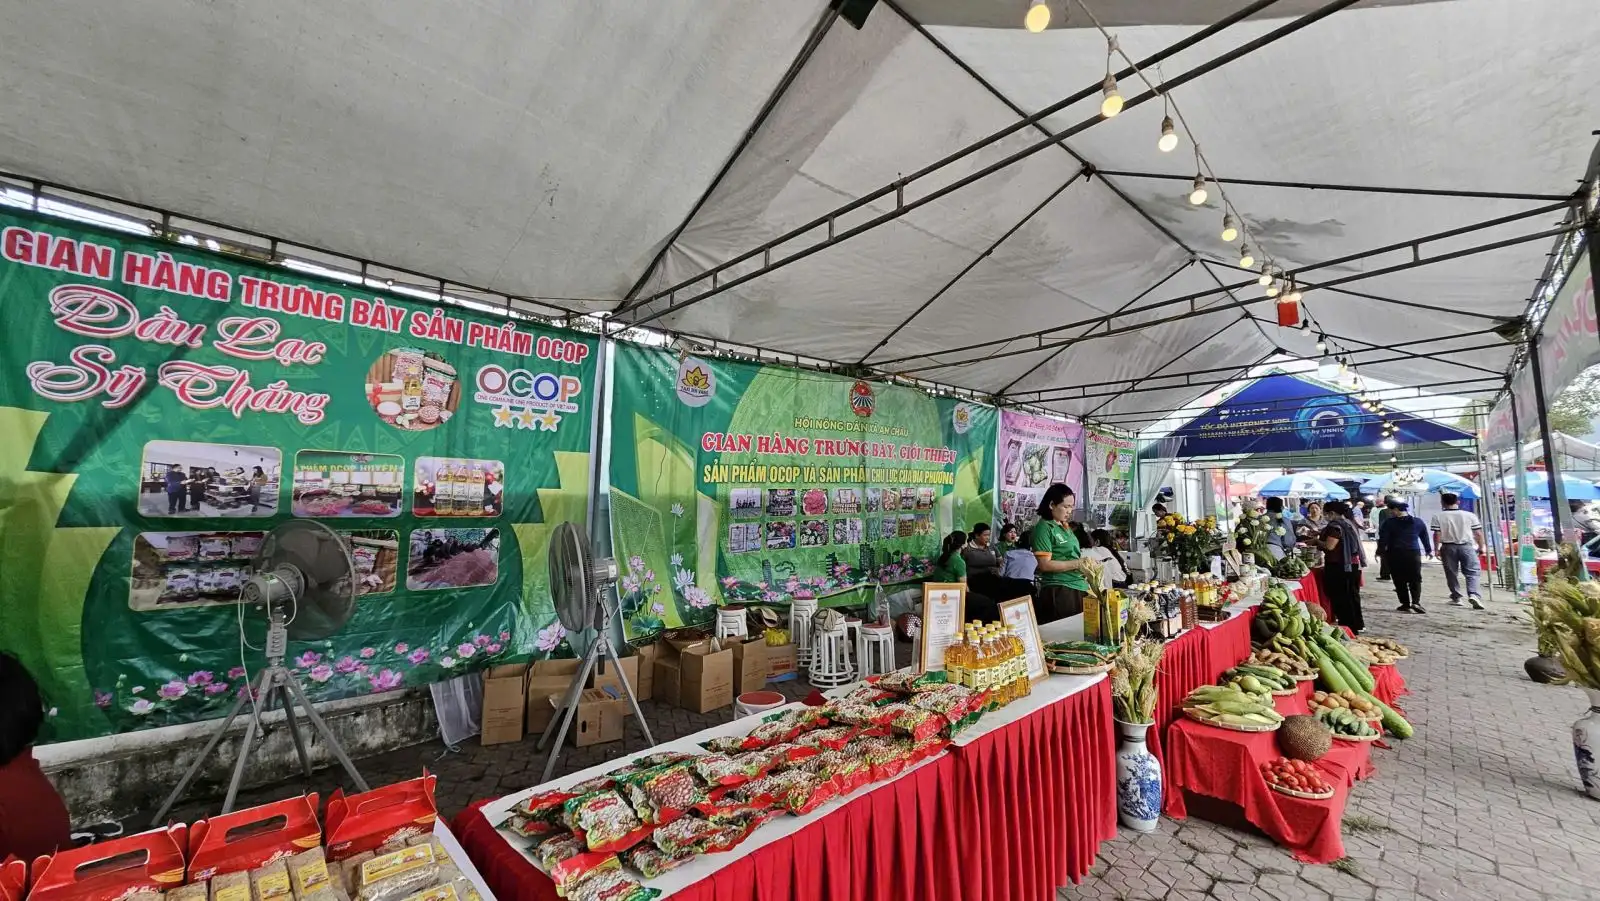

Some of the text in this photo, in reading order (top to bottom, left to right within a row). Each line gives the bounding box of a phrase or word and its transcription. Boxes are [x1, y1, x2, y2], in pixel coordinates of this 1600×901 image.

[1, 226, 589, 364] GIAN HÀNG TRƯNG BÀY SẢN PHẨM OCOP
[49, 284, 327, 367] Dầu Lạc
[27, 344, 331, 425] Sỹ Thắng
[476, 364, 582, 402] OCOP
[794, 416, 813, 432] HỘI
[815, 418, 844, 431] NÔNG
[846, 420, 869, 433] DÂN
[701, 431, 957, 464] GIAN HÀNG TRƯNG BÀY, GIỚI THIỆU
[703, 458, 729, 483] SẢN
[731, 458, 767, 483] PHẨM
[769, 465, 800, 483] OCOP
[803, 464, 816, 483] VÀ
[819, 462, 841, 483] SẢN
